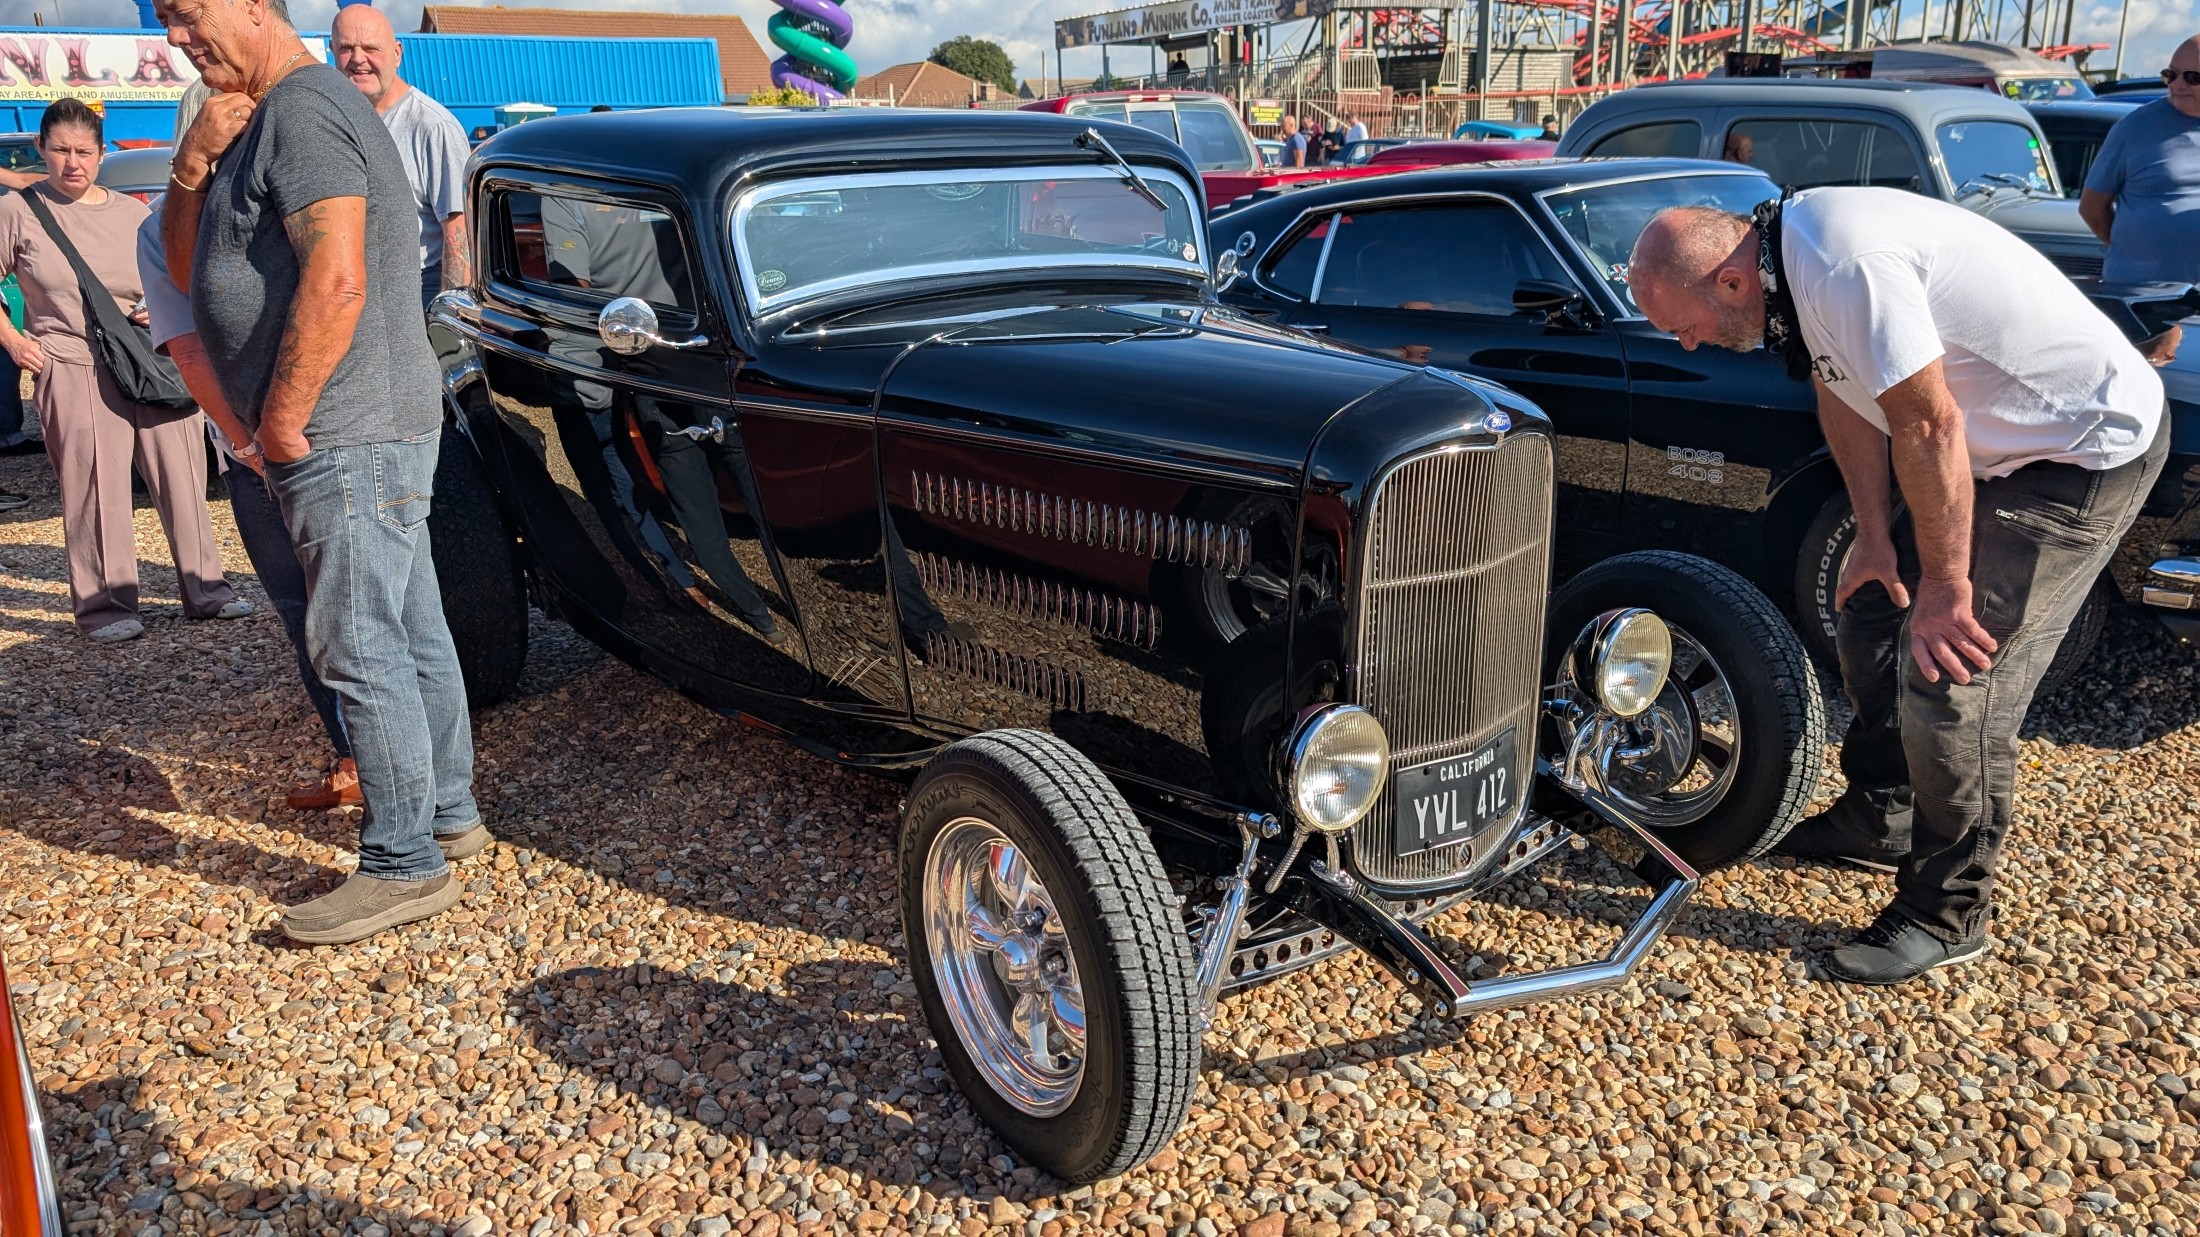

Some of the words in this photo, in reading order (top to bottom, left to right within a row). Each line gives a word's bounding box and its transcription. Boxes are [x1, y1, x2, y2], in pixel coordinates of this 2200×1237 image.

[1087, 20, 1137, 43] FUNLAND
[1142, 11, 1187, 34] MINING
[1215, 13, 1241, 26] ROLLER
[1243, 8, 1277, 20] COASTER
[14, 90, 43, 99] AREA
[50, 90, 98, 99] FUNLAND
[100, 91, 168, 100] AMUSEMENTS
[1667, 445, 1725, 467] BOSS
[1667, 464, 1724, 484] 408
[1440, 748, 1495, 782] CALIFORNIA
[1413, 789, 1468, 839] YVL
[1477, 767, 1507, 819] 412
